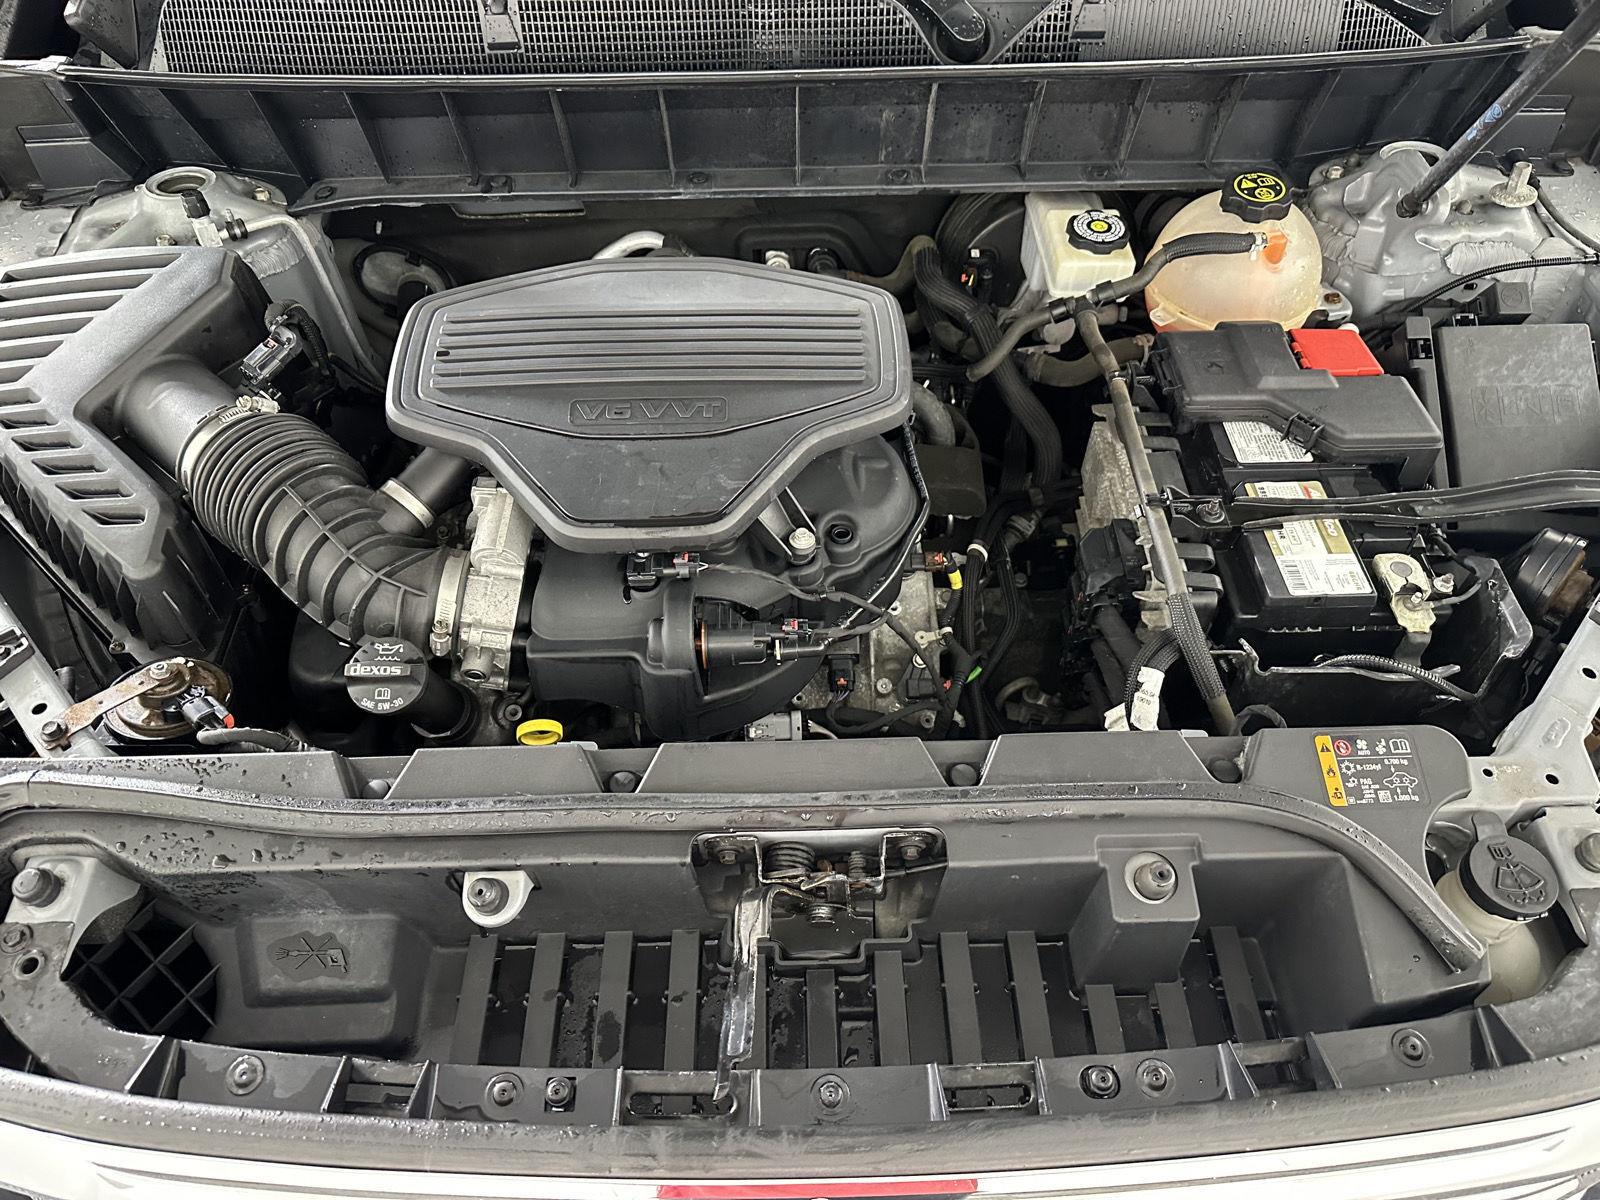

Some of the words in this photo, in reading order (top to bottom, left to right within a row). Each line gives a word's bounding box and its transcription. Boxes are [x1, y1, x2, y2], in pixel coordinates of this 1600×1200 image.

[576, 401, 632, 420] V6
[639, 401, 722, 418] VVT
[349, 663, 404, 676] dexos
[361, 697, 376, 709] SAE
[377, 697, 404, 710] 5W-30
[1400, 758, 1409, 766] kg
[1356, 763, 1382, 771] R-1234yf
[1359, 777, 1373, 785] PAG
[1410, 793, 1420, 802] kg
